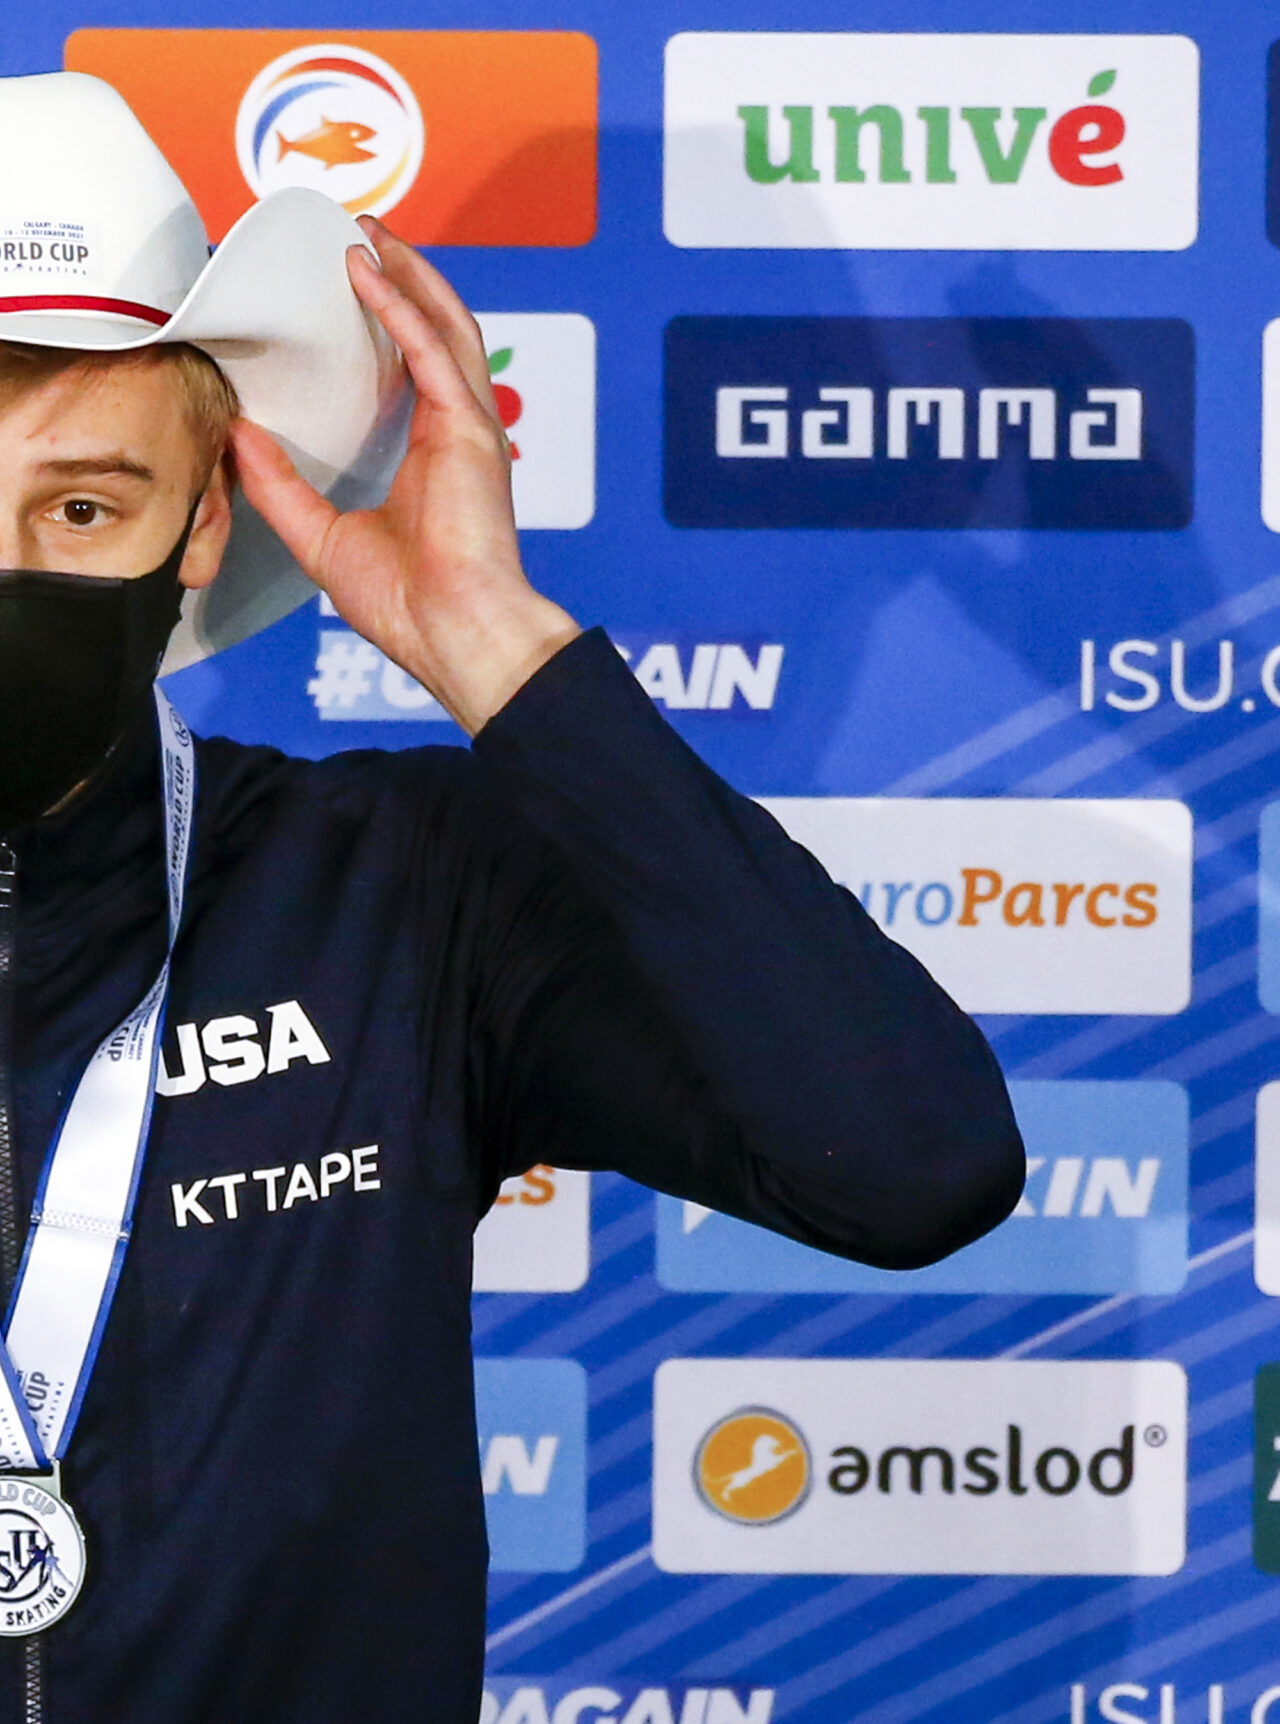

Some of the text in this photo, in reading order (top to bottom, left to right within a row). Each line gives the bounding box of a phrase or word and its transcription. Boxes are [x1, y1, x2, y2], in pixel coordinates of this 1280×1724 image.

[737, 68, 1127, 187] univé
[49, 243, 89, 264] CUP
[155, 999, 332, 1097] USA
[171, 1144, 381, 1228] KT TAPE
[25, 1371, 51, 1412] CUP
[22, 1488, 57, 1517] CUP
[5, 1585, 67, 1627] SKATING
